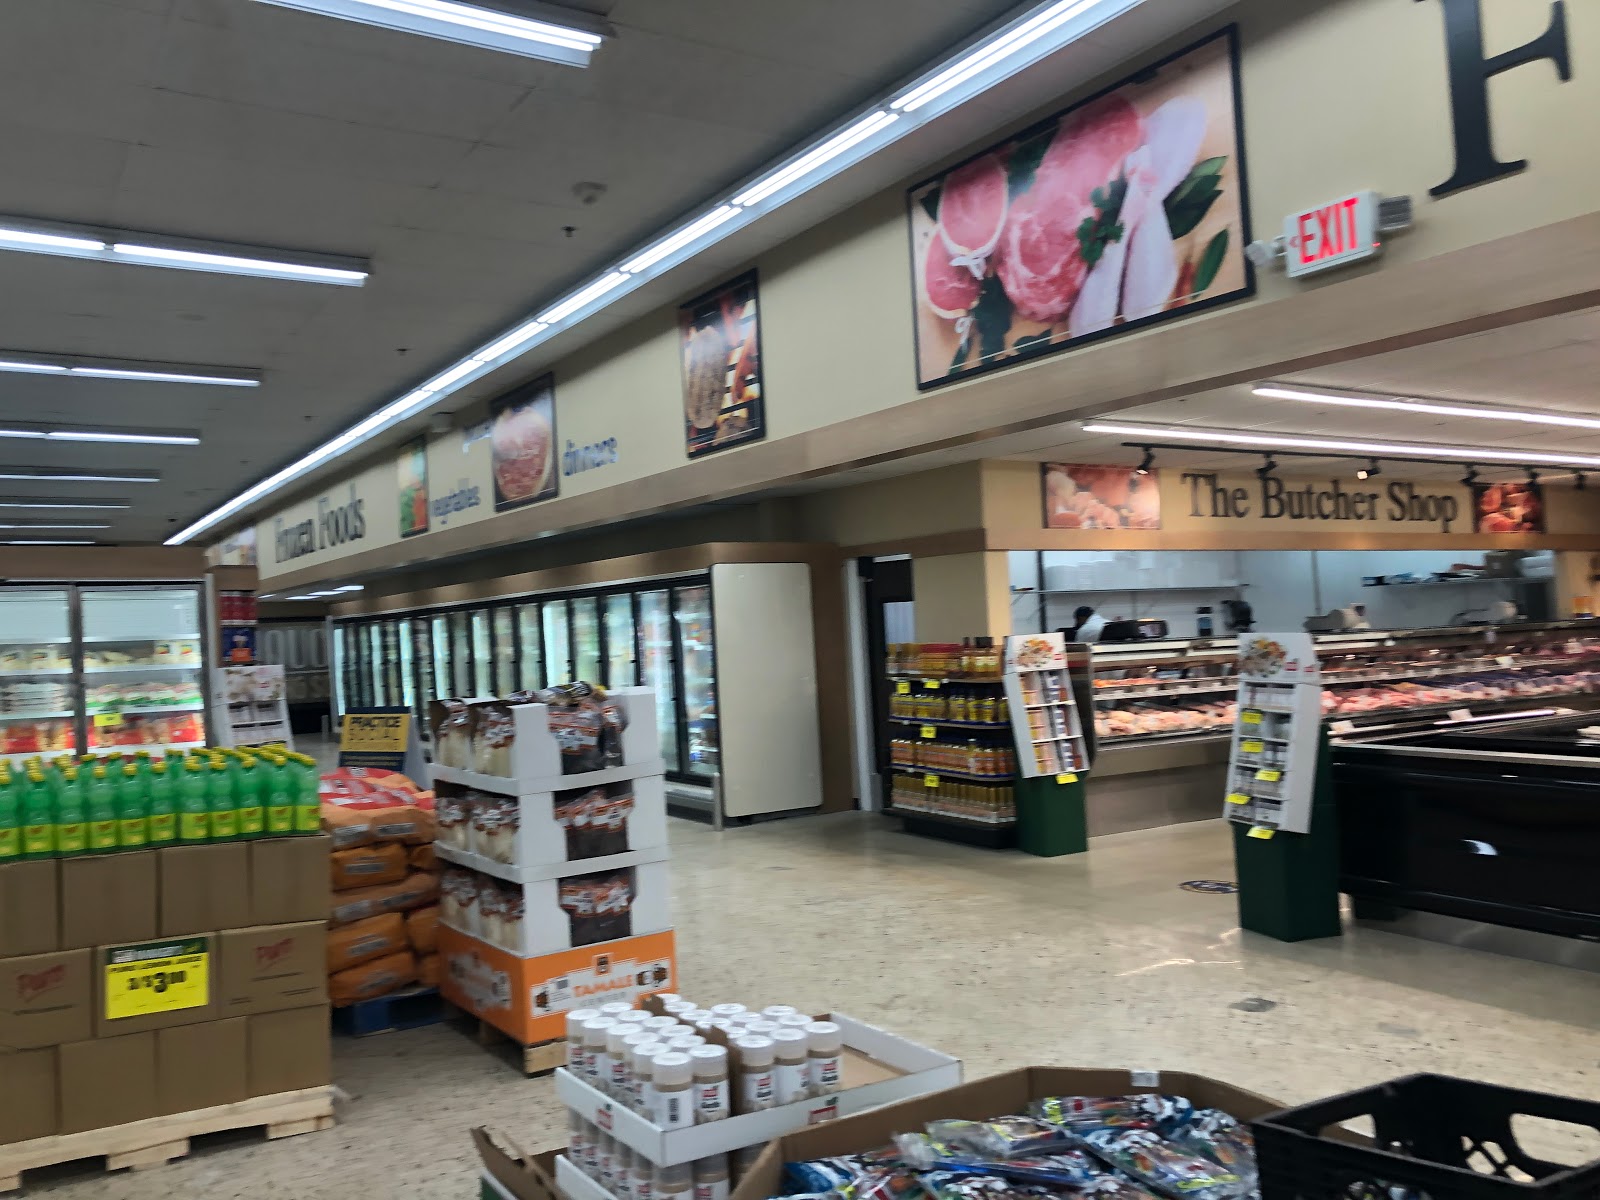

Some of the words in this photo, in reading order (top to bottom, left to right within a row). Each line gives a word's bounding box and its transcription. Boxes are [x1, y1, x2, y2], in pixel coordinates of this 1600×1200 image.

[1415, 0, 1571, 197] F
[1298, 197, 1359, 264] EXIT
[318, 482, 367, 550] Foods
[1180, 473, 1251, 518] The
[1259, 477, 1380, 520] Butcher
[1386, 481, 1458, 533] Shop
